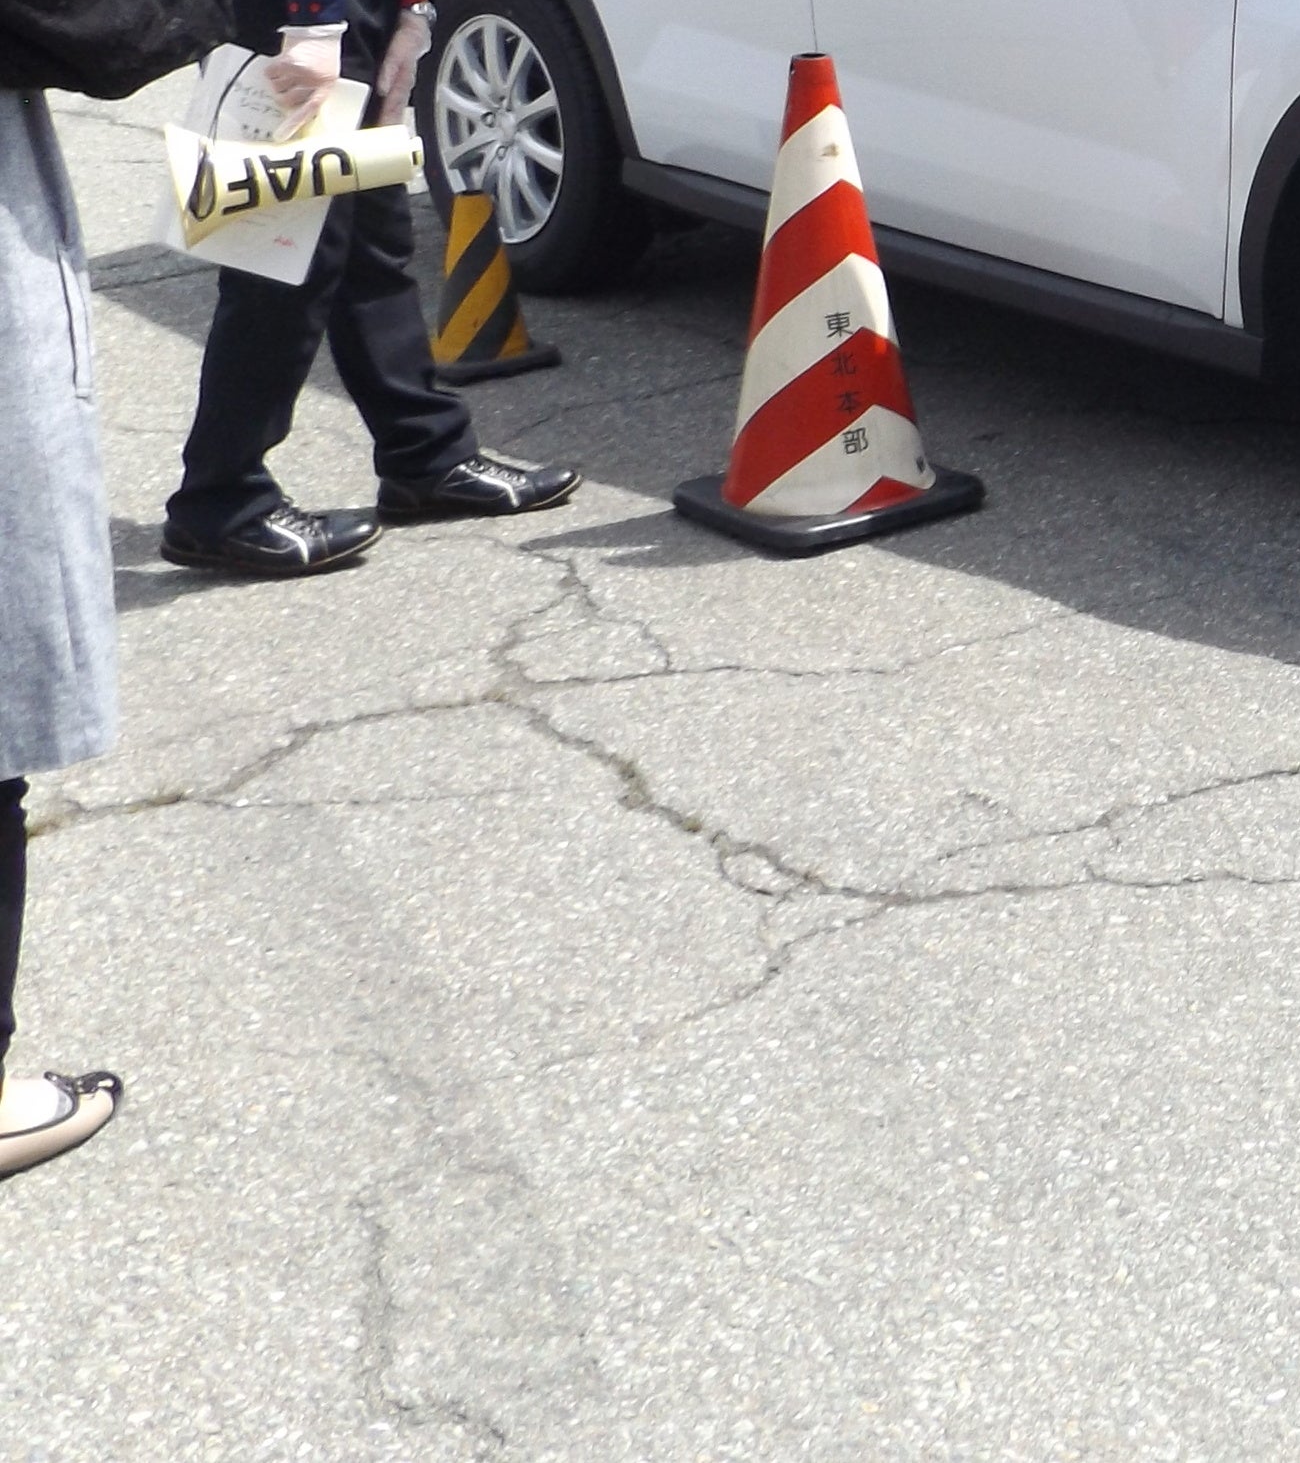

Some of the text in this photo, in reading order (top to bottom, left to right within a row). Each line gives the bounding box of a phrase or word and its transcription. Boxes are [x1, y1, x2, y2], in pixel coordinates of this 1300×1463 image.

[221, 146, 354, 216] JAF
[824, 311, 870, 455] 東北本部
